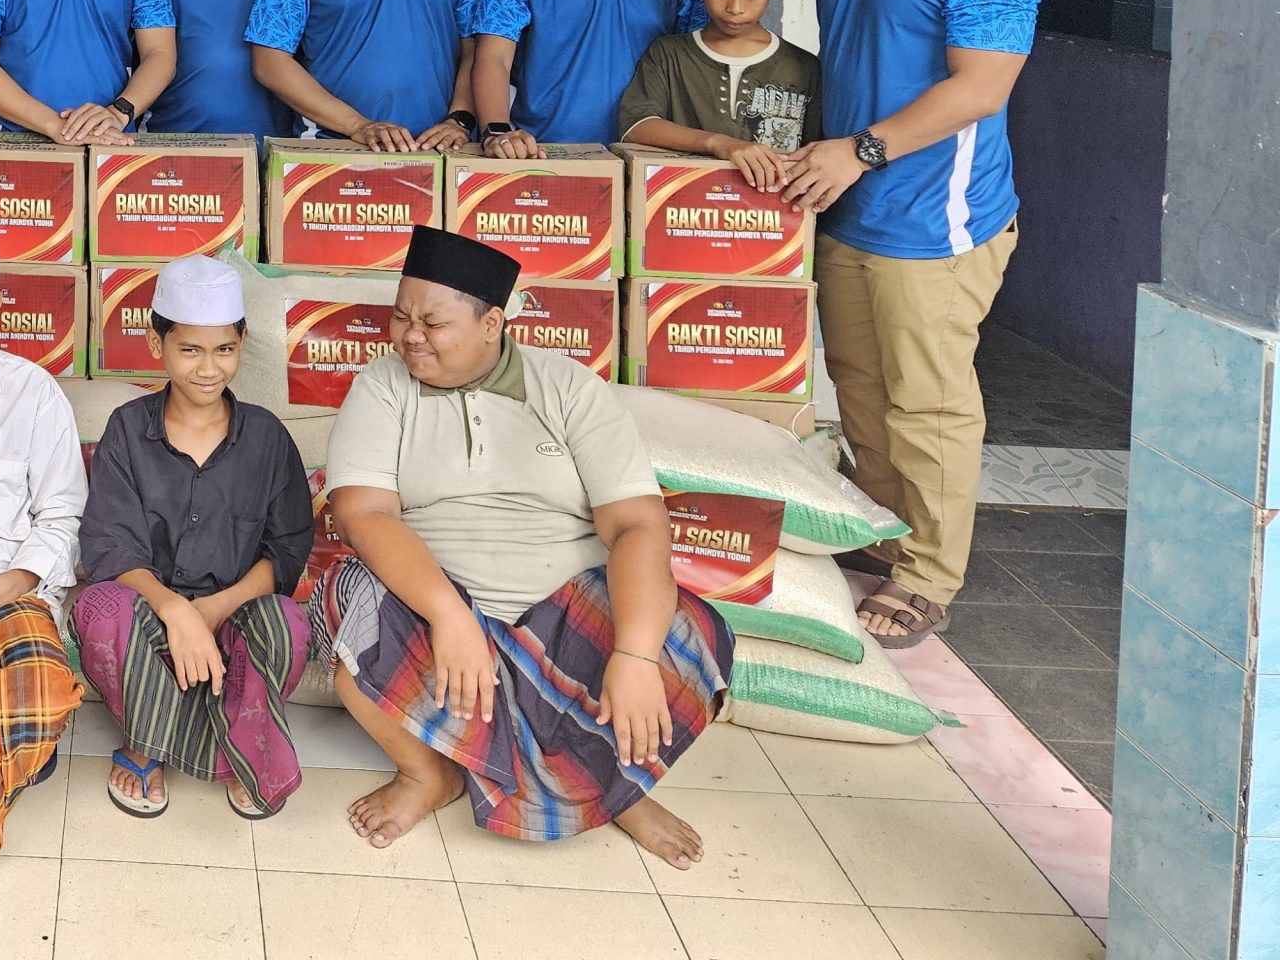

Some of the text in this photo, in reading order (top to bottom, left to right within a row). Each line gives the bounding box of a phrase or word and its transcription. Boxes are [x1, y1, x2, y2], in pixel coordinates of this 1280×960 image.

[0, 197, 54, 219] SOSIAL
[116, 193, 224, 215] BAKTI SOSIAL
[302, 202, 414, 225] BAKTI SOSIAL
[477, 212, 591, 237] BAKTI SOSIAL
[666, 207, 784, 232] BAKTI SOSIAL
[1, 312, 55, 333] SOSIAL
[122, 307, 152, 328] BAK
[533, 325, 593, 348] SOSIAL
[667, 323, 786, 349] BAKTI SOSIAL
[307, 340, 360, 363] BAKTI
[686, 526, 752, 555] SOSIAL
